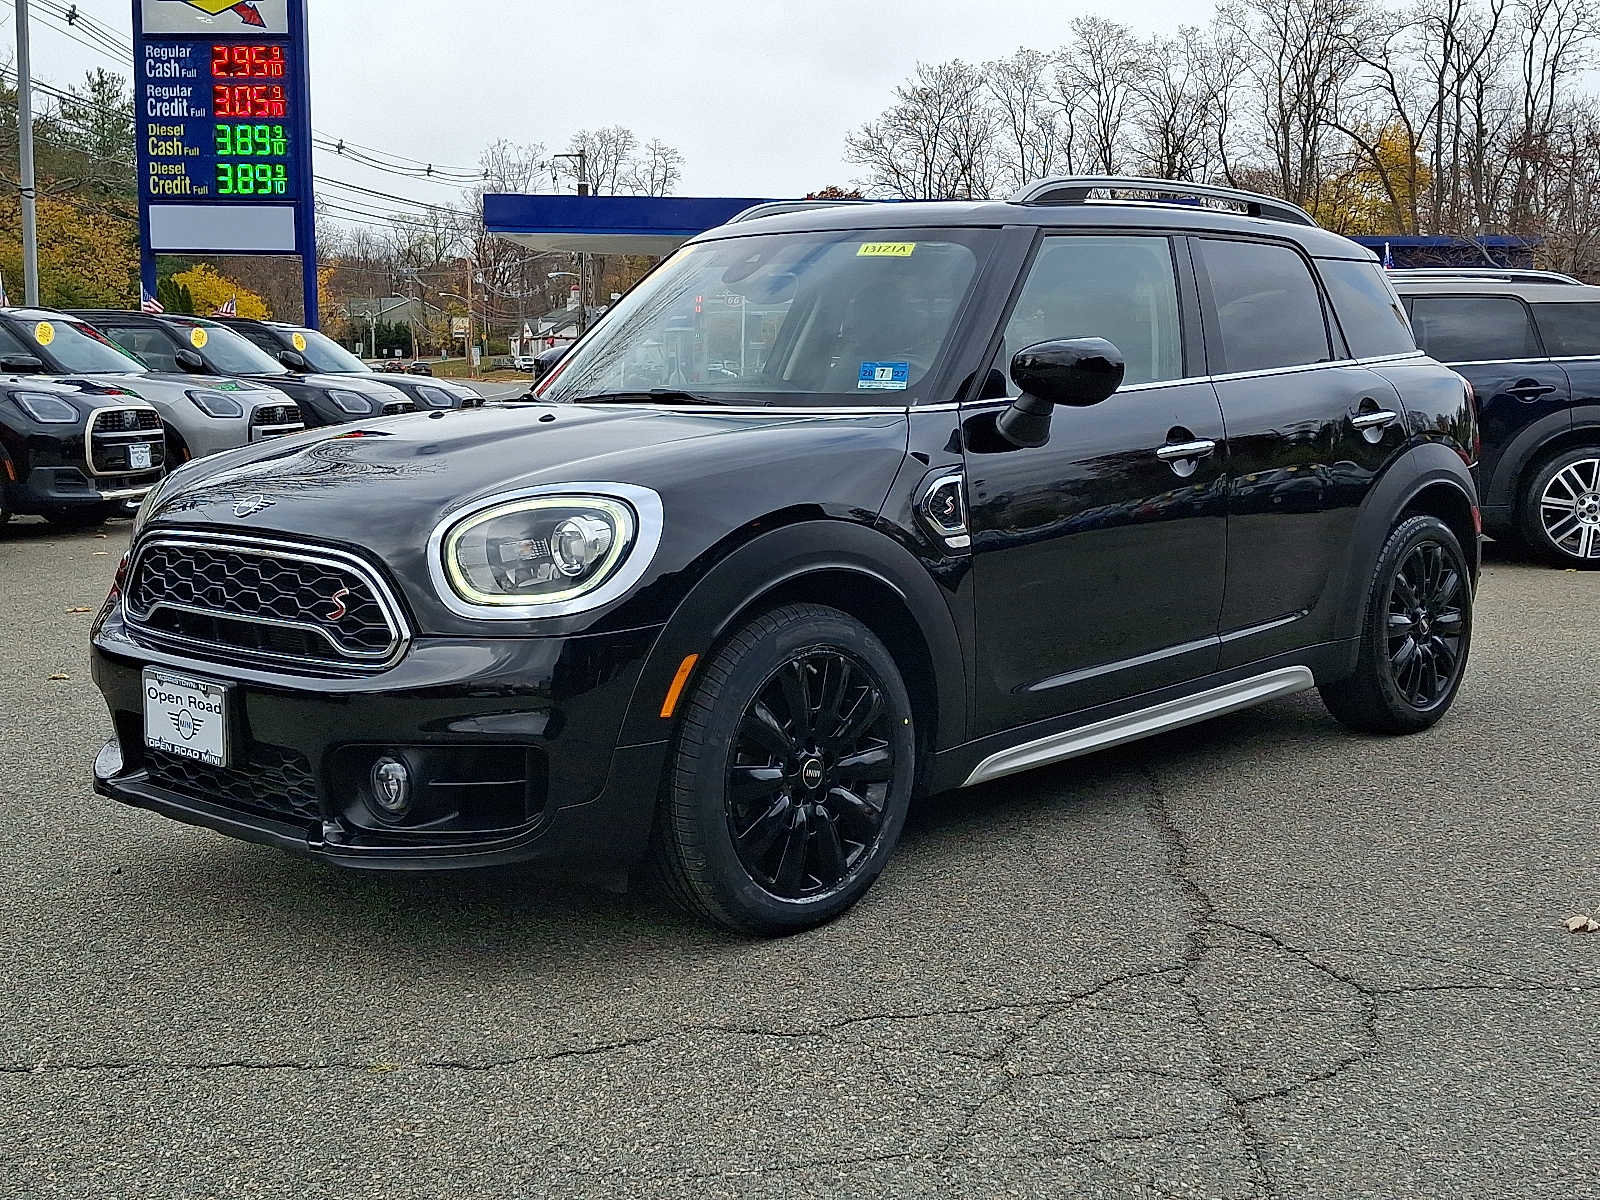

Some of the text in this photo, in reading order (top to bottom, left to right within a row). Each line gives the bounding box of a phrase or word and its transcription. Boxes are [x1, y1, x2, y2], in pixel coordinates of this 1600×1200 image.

[146, 45, 191, 60] Regular
[213, 46, 268, 77] 2.95
[146, 60, 197, 78] Cash Full
[147, 84, 192, 99] Regular
[147, 99, 205, 117] Credit Full
[214, 86, 269, 116] 3.05
[148, 124, 184, 136] Diesel
[148, 137, 199, 156] Cash Full
[216, 124, 270, 156] 3.89
[149, 162, 185, 175] Diesel
[150, 176, 208, 194] Credit Full
[216, 164, 272, 194] 3.89
[880, 369, 886, 378] 7
[943, 496, 954, 514] S
[326, 588, 349, 620] S
[148, 687, 221, 714] Open Road
[148, 739, 220, 766] OPEN ROAD MINI
